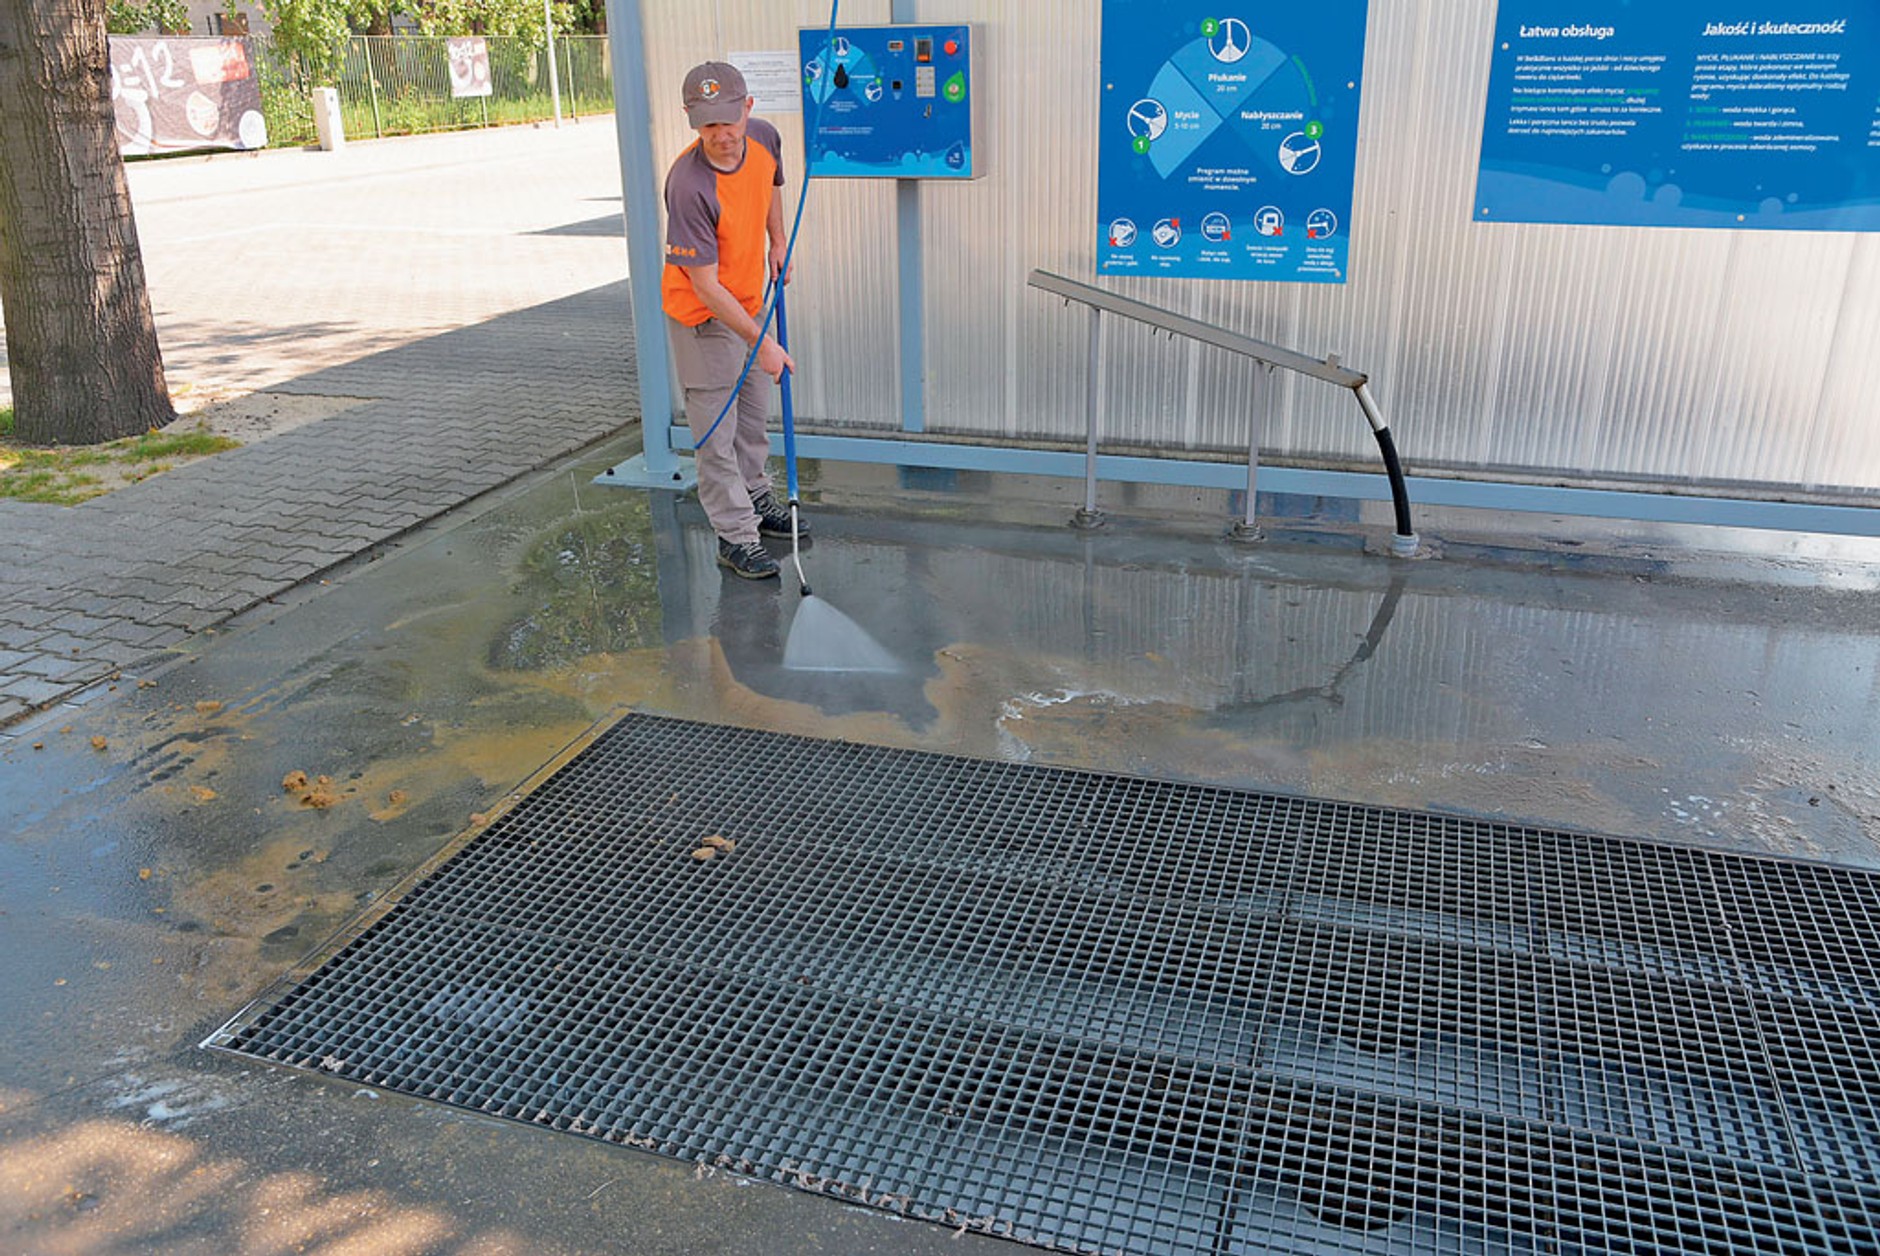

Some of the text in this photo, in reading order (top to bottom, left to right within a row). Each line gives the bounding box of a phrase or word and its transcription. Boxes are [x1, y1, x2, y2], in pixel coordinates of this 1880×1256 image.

[1206, 23, 1213, 32] 2
[1520, 25, 1614, 39] Łatwa obsługa
[1702, 19, 1846, 37] Jakość i skuteczność
[1208, 73, 1247, 82] Płukanie
[1175, 111, 1200, 121] Mycie
[1241, 111, 1303, 121] Nabłyszczanie
[1310, 126, 1317, 135] 3
[1138, 140, 1144, 150] 1
